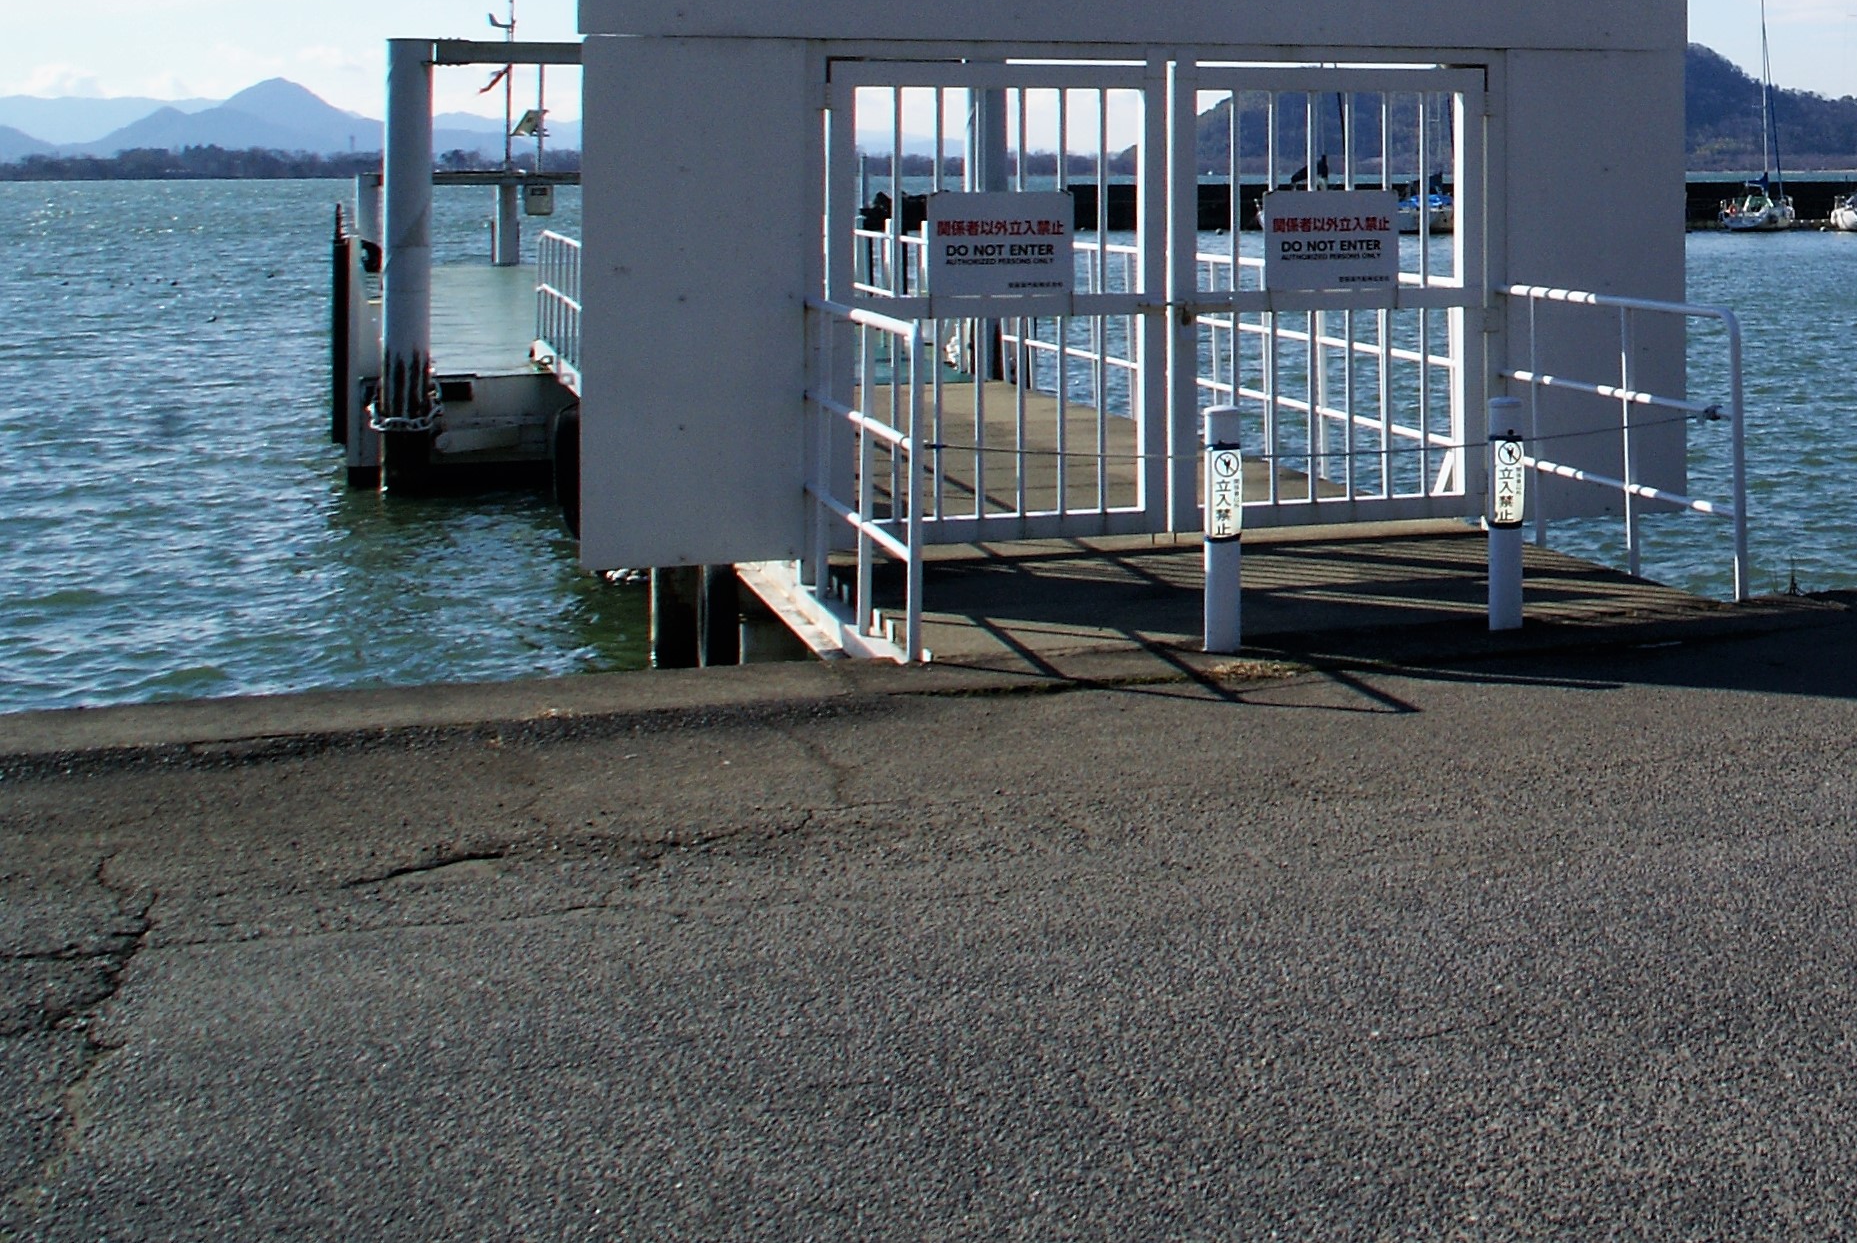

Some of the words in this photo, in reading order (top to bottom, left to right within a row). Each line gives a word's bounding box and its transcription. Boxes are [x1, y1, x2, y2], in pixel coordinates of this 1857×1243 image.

[937, 219, 1064, 236] 関係者以外立入禁止
[1273, 216, 1390, 232] 関係者以外立入禁止
[946, 244, 968, 257] DO
[974, 243, 1004, 256] NOT
[1010, 243, 1054, 255] ENTER
[1282, 241, 1302, 253] DO
[1307, 240, 1335, 252] NOT
[1340, 239, 1380, 251] ENTER
[945, 257, 995, 265] AUTHORIZED
[1499, 467, 1514, 522] 立入禁止
[1215, 479, 1232, 536] 立入禁止
